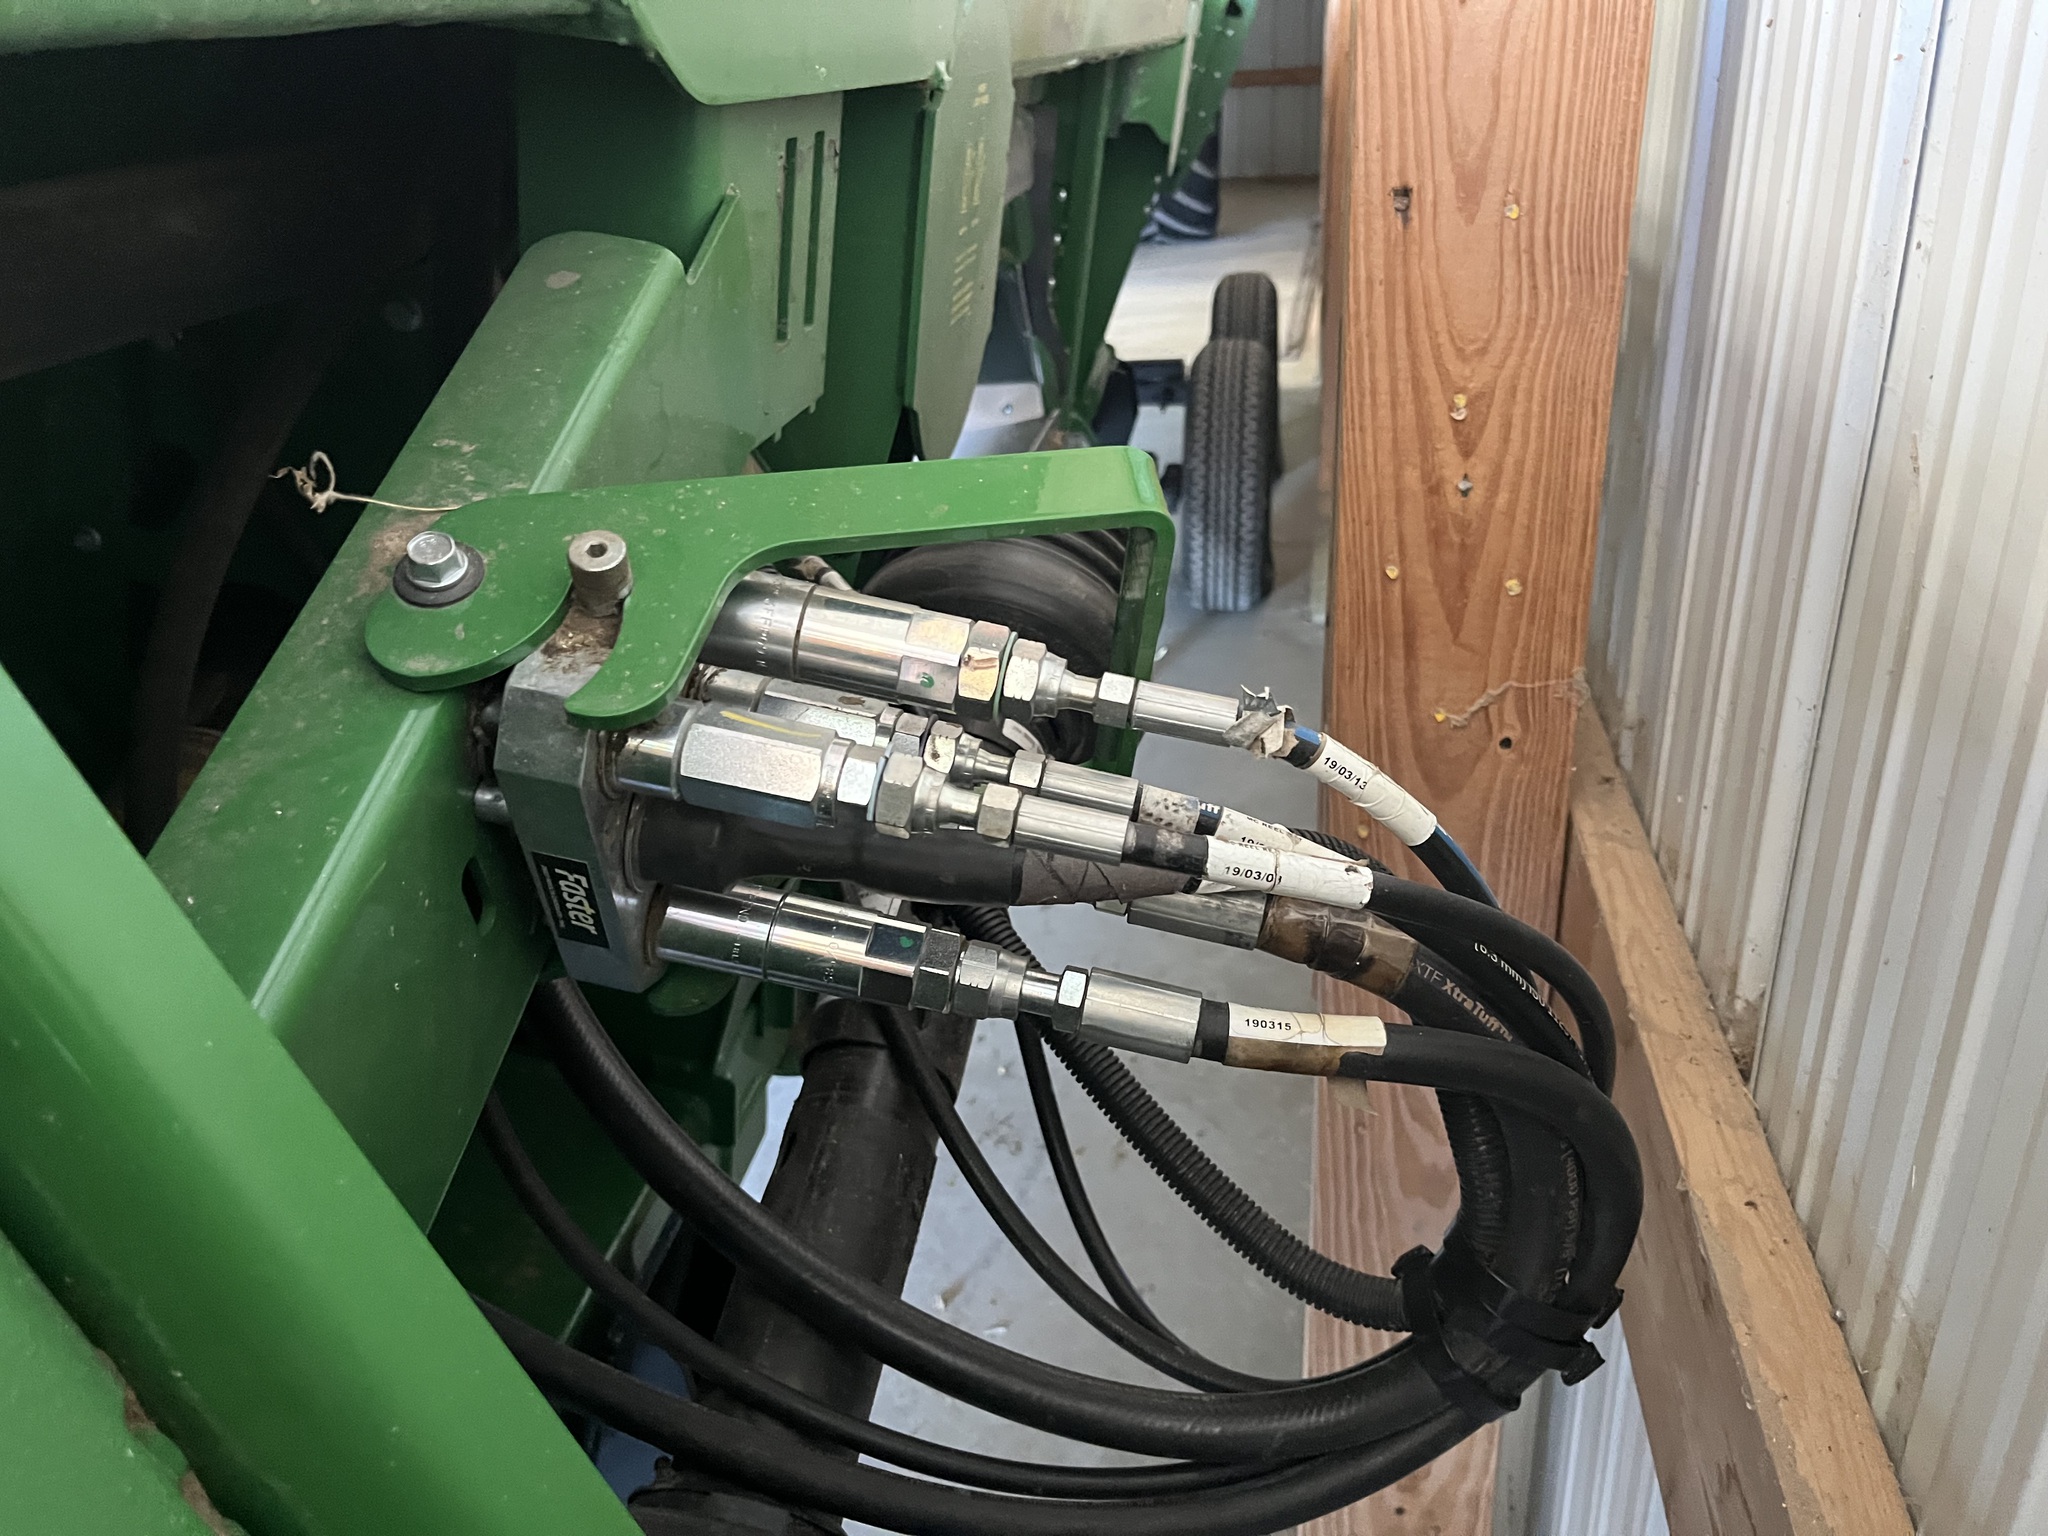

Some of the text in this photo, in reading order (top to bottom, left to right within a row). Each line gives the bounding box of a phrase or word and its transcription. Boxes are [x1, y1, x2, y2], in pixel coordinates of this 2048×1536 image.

[1324, 757, 1368, 790] 19/03/13
[554, 868, 598, 935] Faster
[1413, 959, 1443, 984] XTF
[1245, 1018, 1291, 1031] 190315
